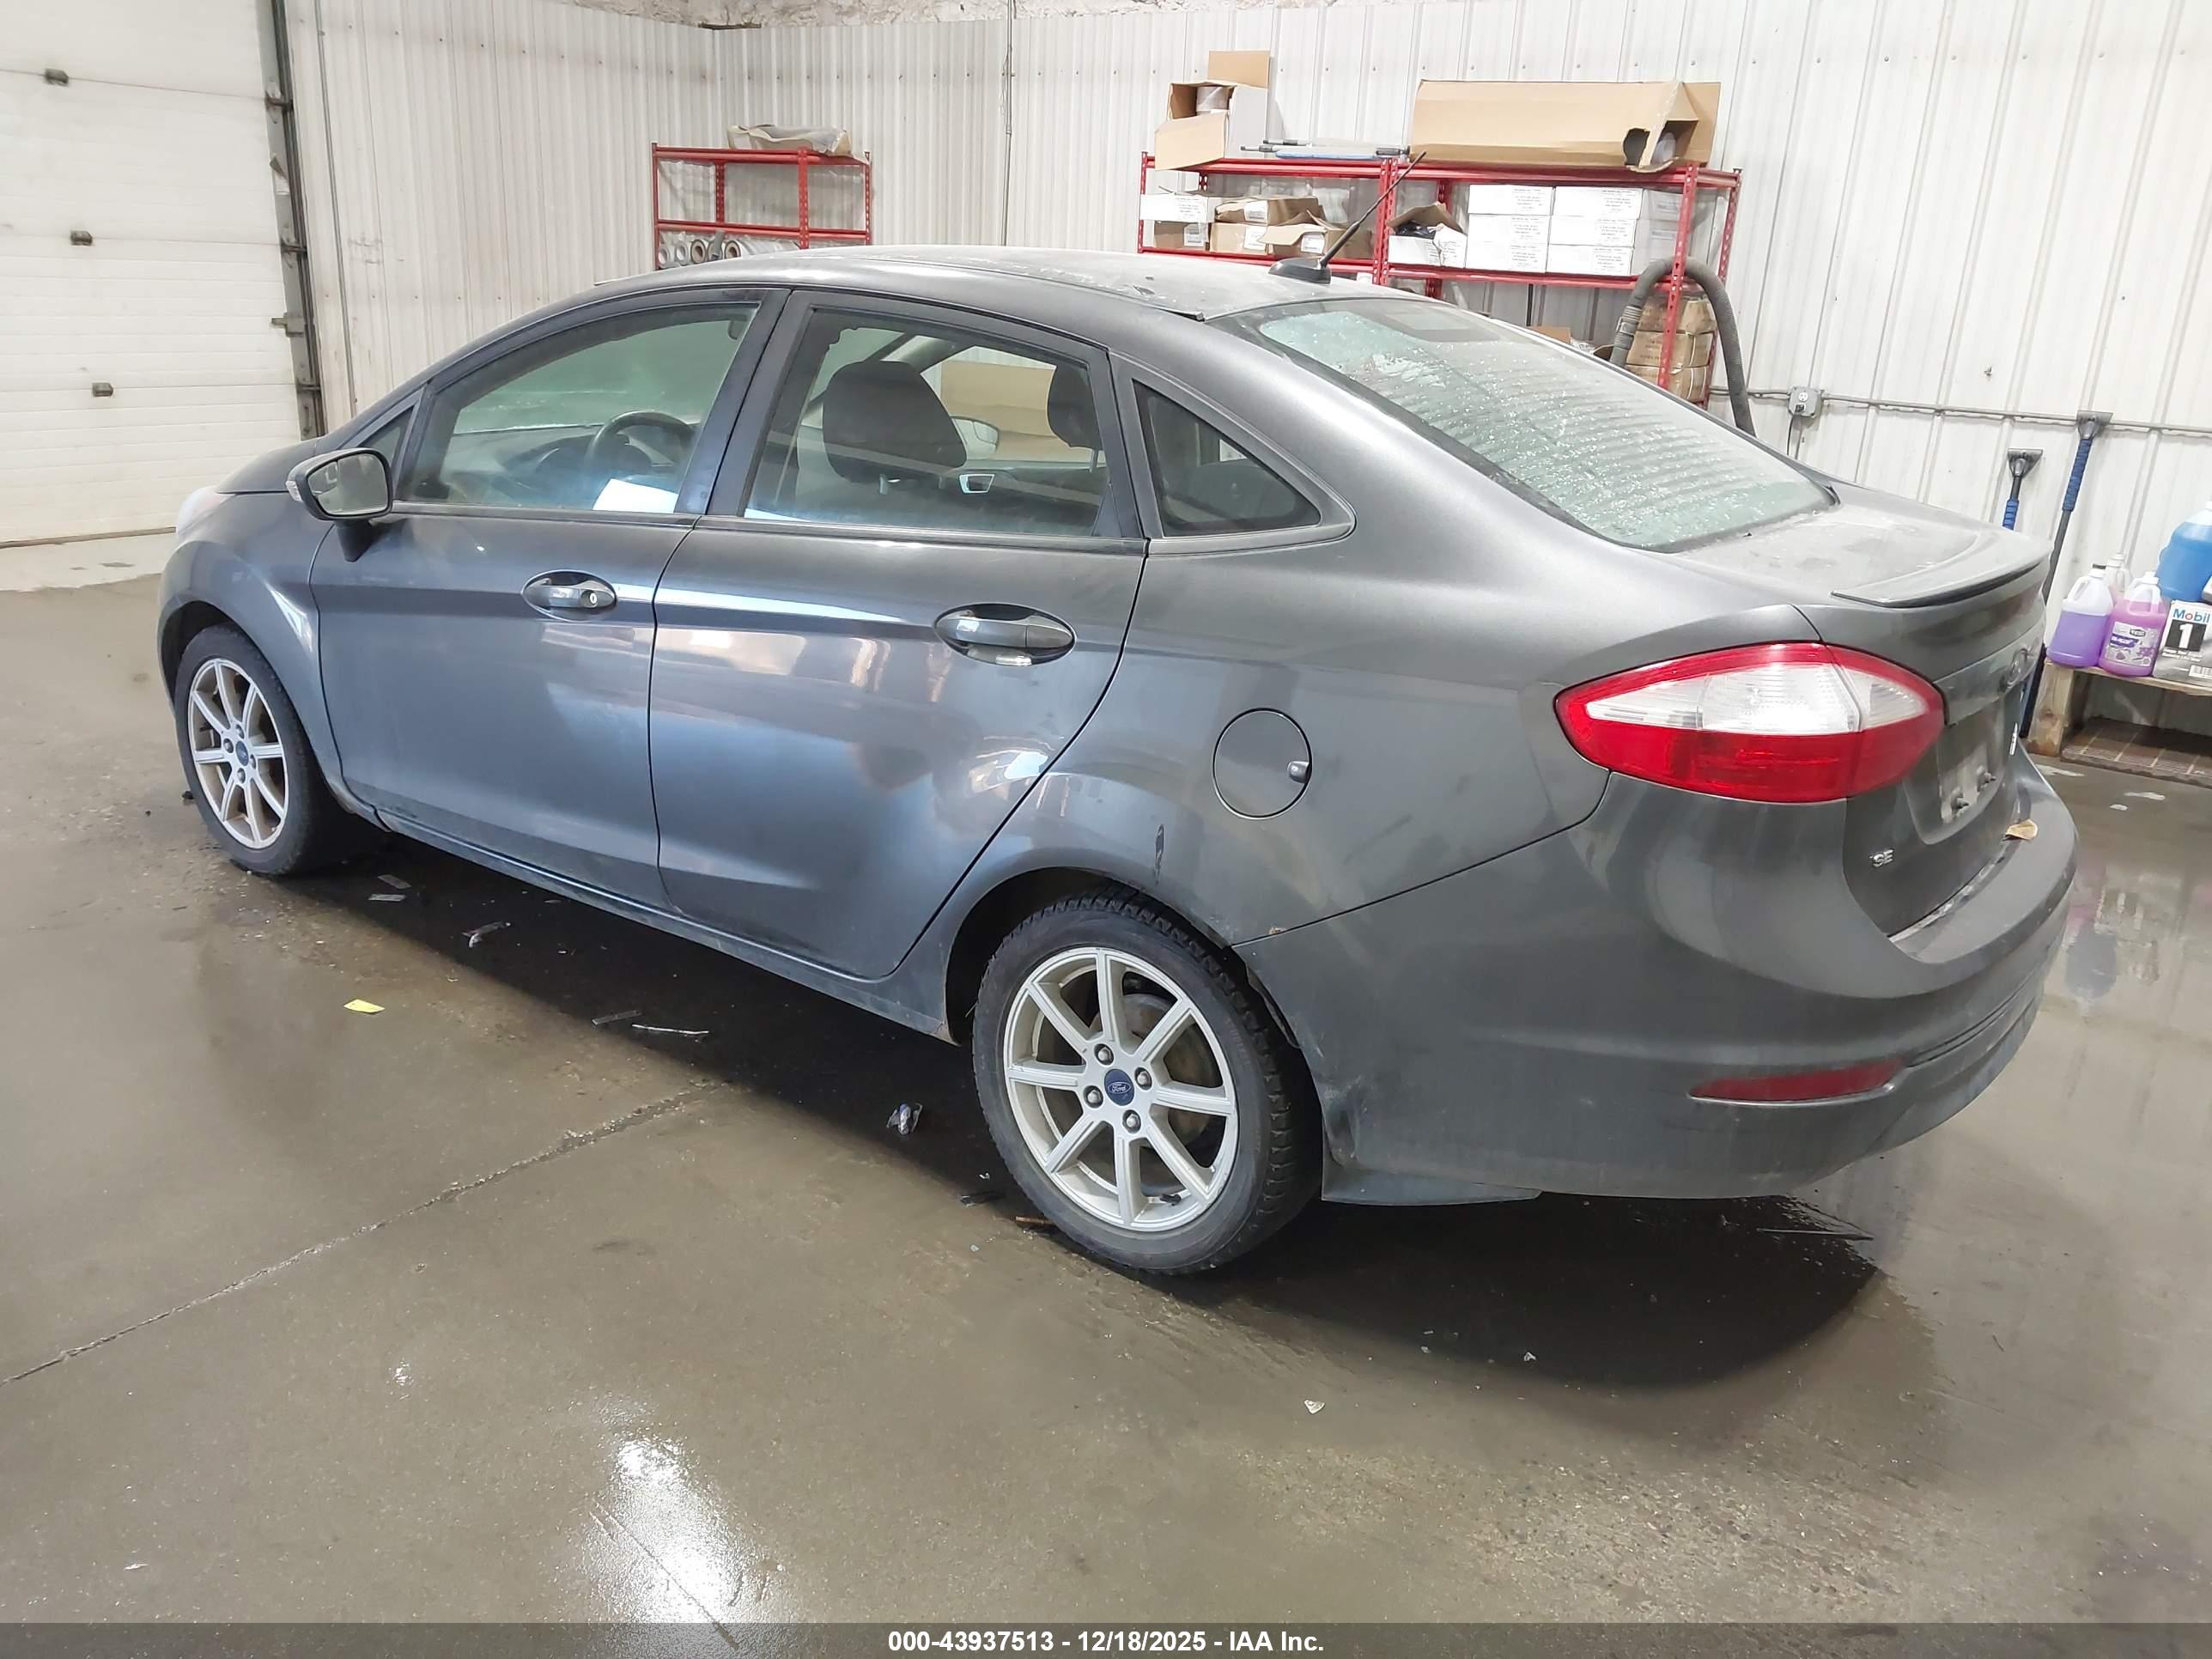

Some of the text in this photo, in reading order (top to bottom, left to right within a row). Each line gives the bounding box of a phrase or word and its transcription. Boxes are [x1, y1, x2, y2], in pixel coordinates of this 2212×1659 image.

[2172, 608, 2210, 623] Mobil
[2179, 623, 2194, 649] 1
[1873, 849, 1893, 868] SE
[1111, 1084, 1127, 1092] Ford
